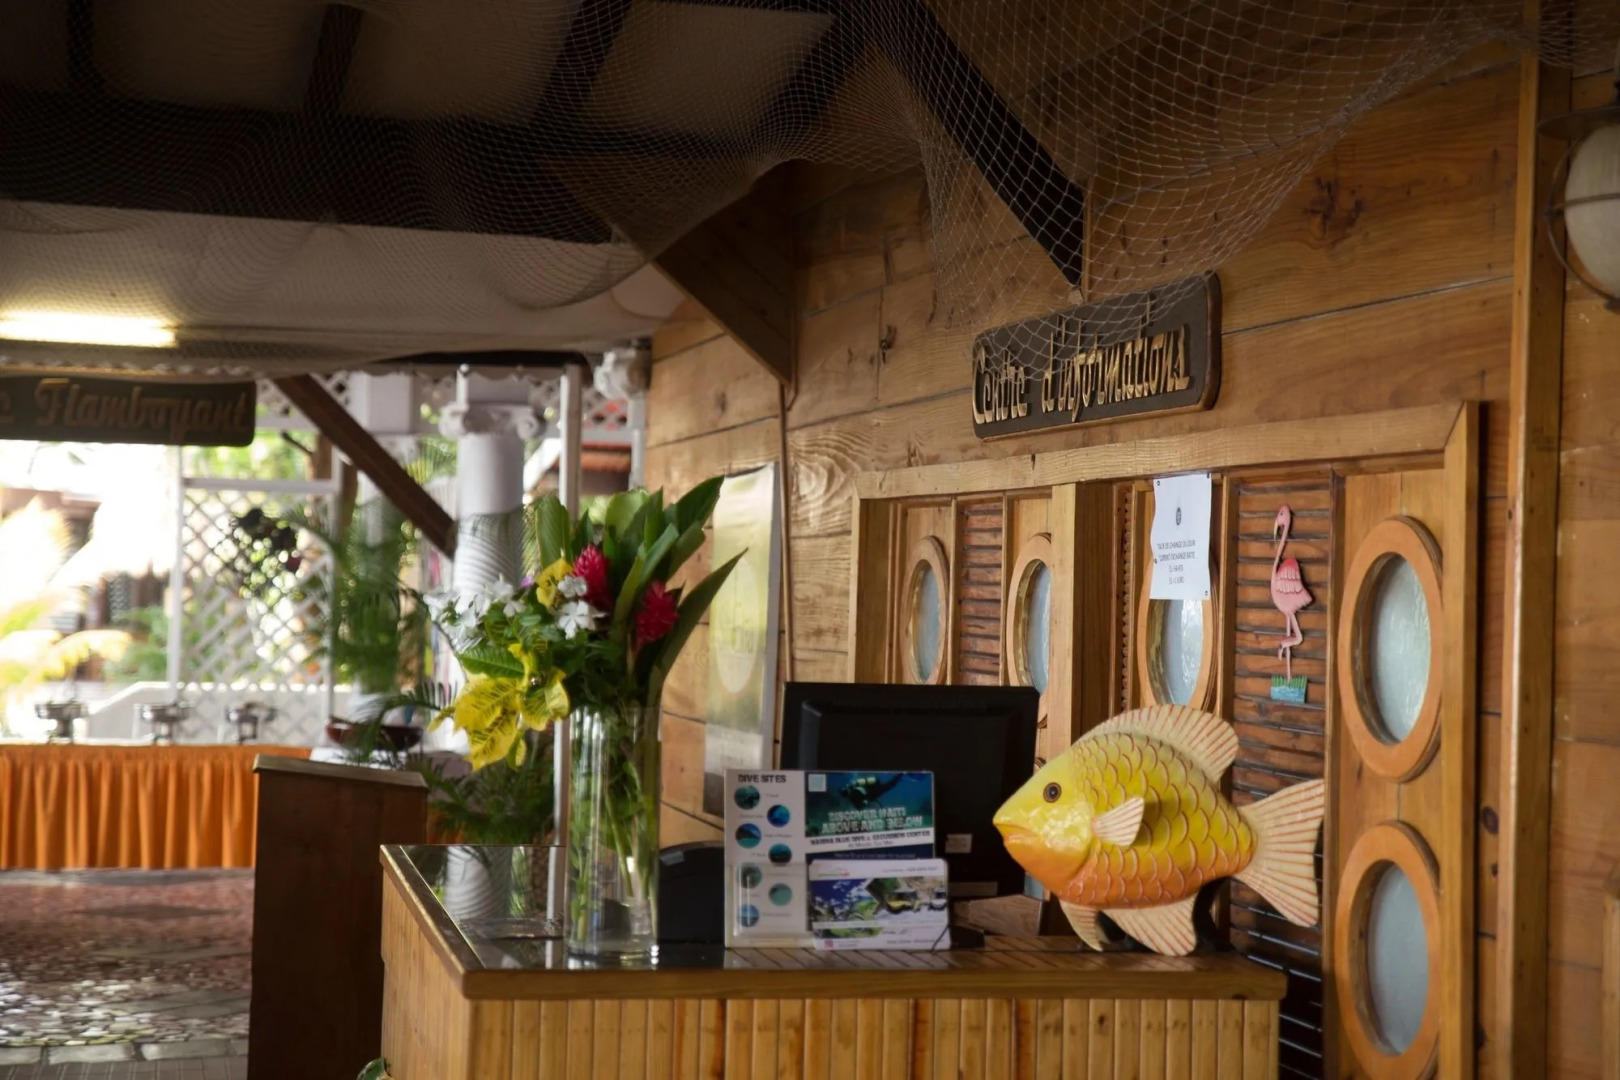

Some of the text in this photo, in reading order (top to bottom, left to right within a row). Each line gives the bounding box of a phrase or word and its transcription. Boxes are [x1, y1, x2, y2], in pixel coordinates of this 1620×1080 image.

[972, 345, 1028, 424] Centre
[34, 377, 250, 444] Flamboyant
[738, 774, 787, 783] DIVE SITES
[828, 811, 878, 822] DISCOVER
[821, 817, 923, 834] ABOVE AND BELOW
[906, 829, 931, 838] CENTER
